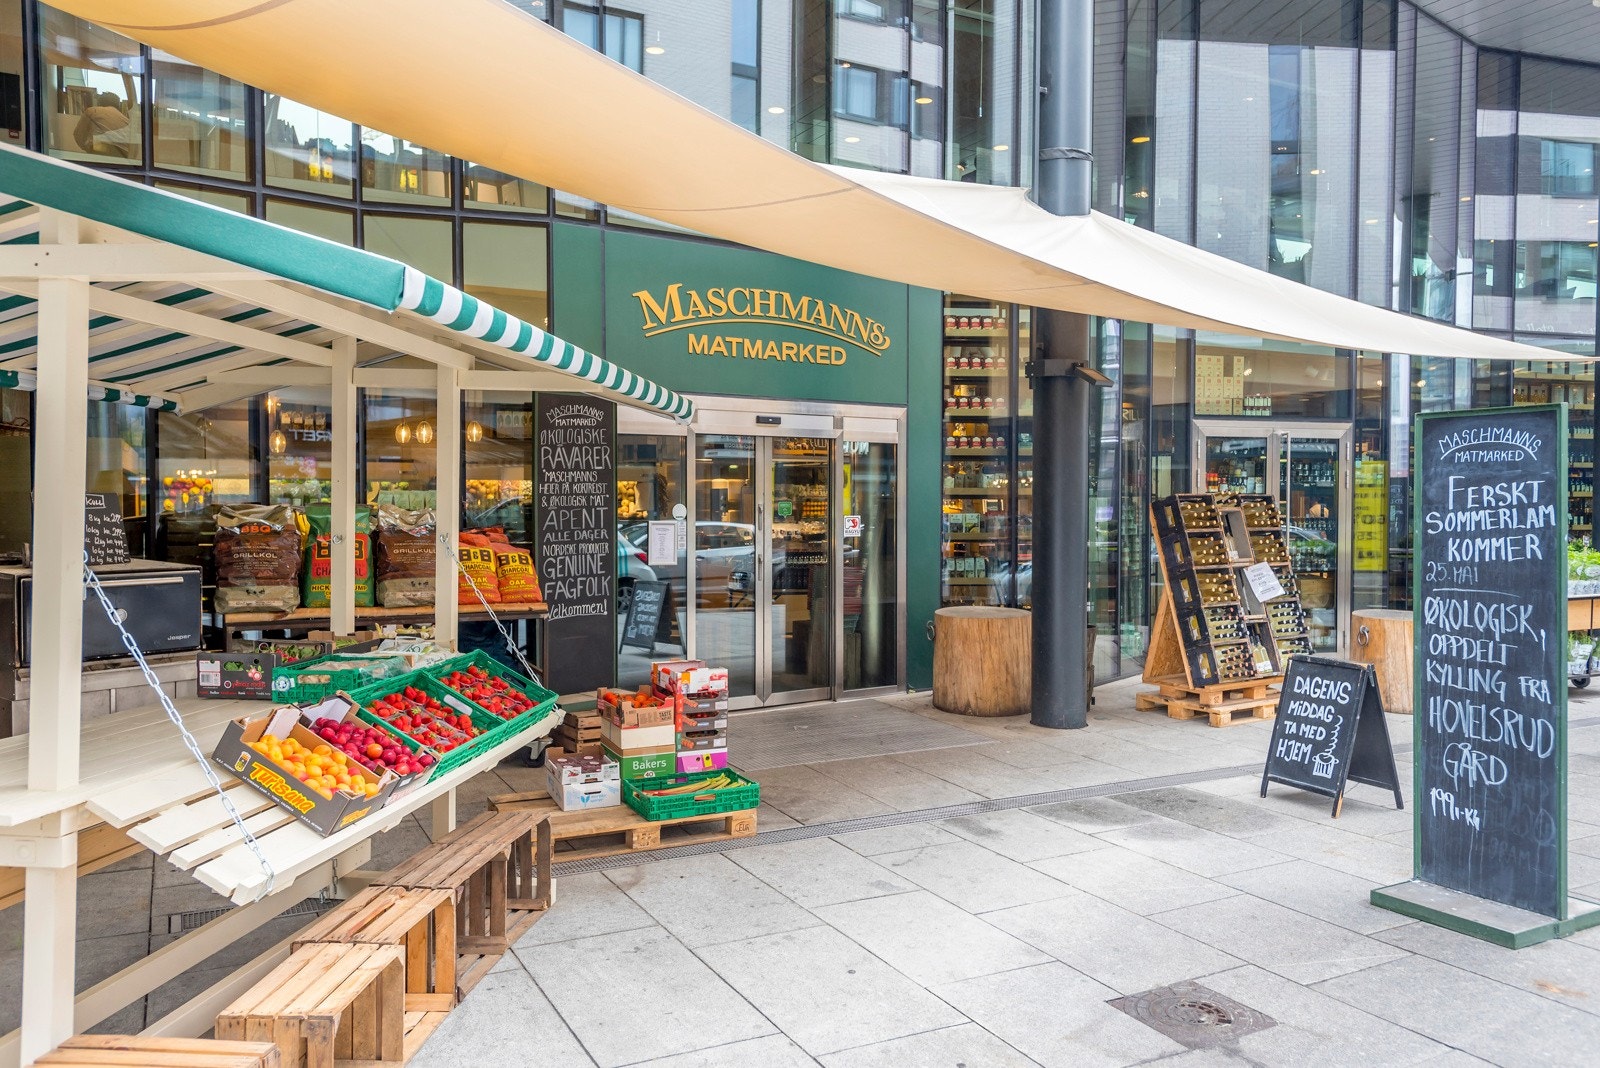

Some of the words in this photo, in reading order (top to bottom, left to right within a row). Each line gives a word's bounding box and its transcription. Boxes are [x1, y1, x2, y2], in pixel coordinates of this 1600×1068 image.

[632, 283, 891, 350] MASCHMANNS
[688, 333, 847, 366] MATMARKED
[546, 404, 605, 421] MASCHMANNS
[555, 418, 597, 427] MATMARKED
[540, 428, 608, 445] ØKOLOGISKE
[1438, 427, 1541, 453] MASCHMANNS
[541, 444, 612, 470] RÅVARER
[1455, 449, 1525, 463] MATMARKED
[539, 483, 560, 495] HEIER
[561, 482, 570, 494] PÅ
[572, 482, 608, 494] KORTREIST
[541, 495, 548, 507] &
[549, 495, 587, 507] ØKOLOGISK
[1448, 475, 1546, 510] FERSKT
[241, 525, 271, 533] BBQ
[542, 506, 609, 531] ÅPENT
[1425, 505, 1557, 535] SOMMERLAM
[543, 530, 571, 542] ALLE
[574, 528, 609, 541] DAGER
[542, 543, 577, 556] NORDISKE
[578, 542, 610, 555] PRODUKTER
[1448, 533, 1543, 563] KOMMER
[543, 553, 607, 580] GENUINE
[1453, 565, 1479, 585] MAI
[544, 575, 611, 600] FAGFOLK
[547, 598, 608, 619] Velkommen!
[1429, 633, 1518, 666] OPPDELT
[1293, 675, 1352, 705] DAGENS
[1426, 658, 1507, 702] KYLLING
[1518, 676, 1551, 704] FRA
[1284, 720, 1297, 735] TA
[1299, 723, 1327, 741] MED
[1429, 695, 1555, 759] HOVELSRUD
[632, 759, 668, 770] Bakers
[1276, 739, 1313, 765] HJEM
[1443, 742, 1508, 792] GÅRD
